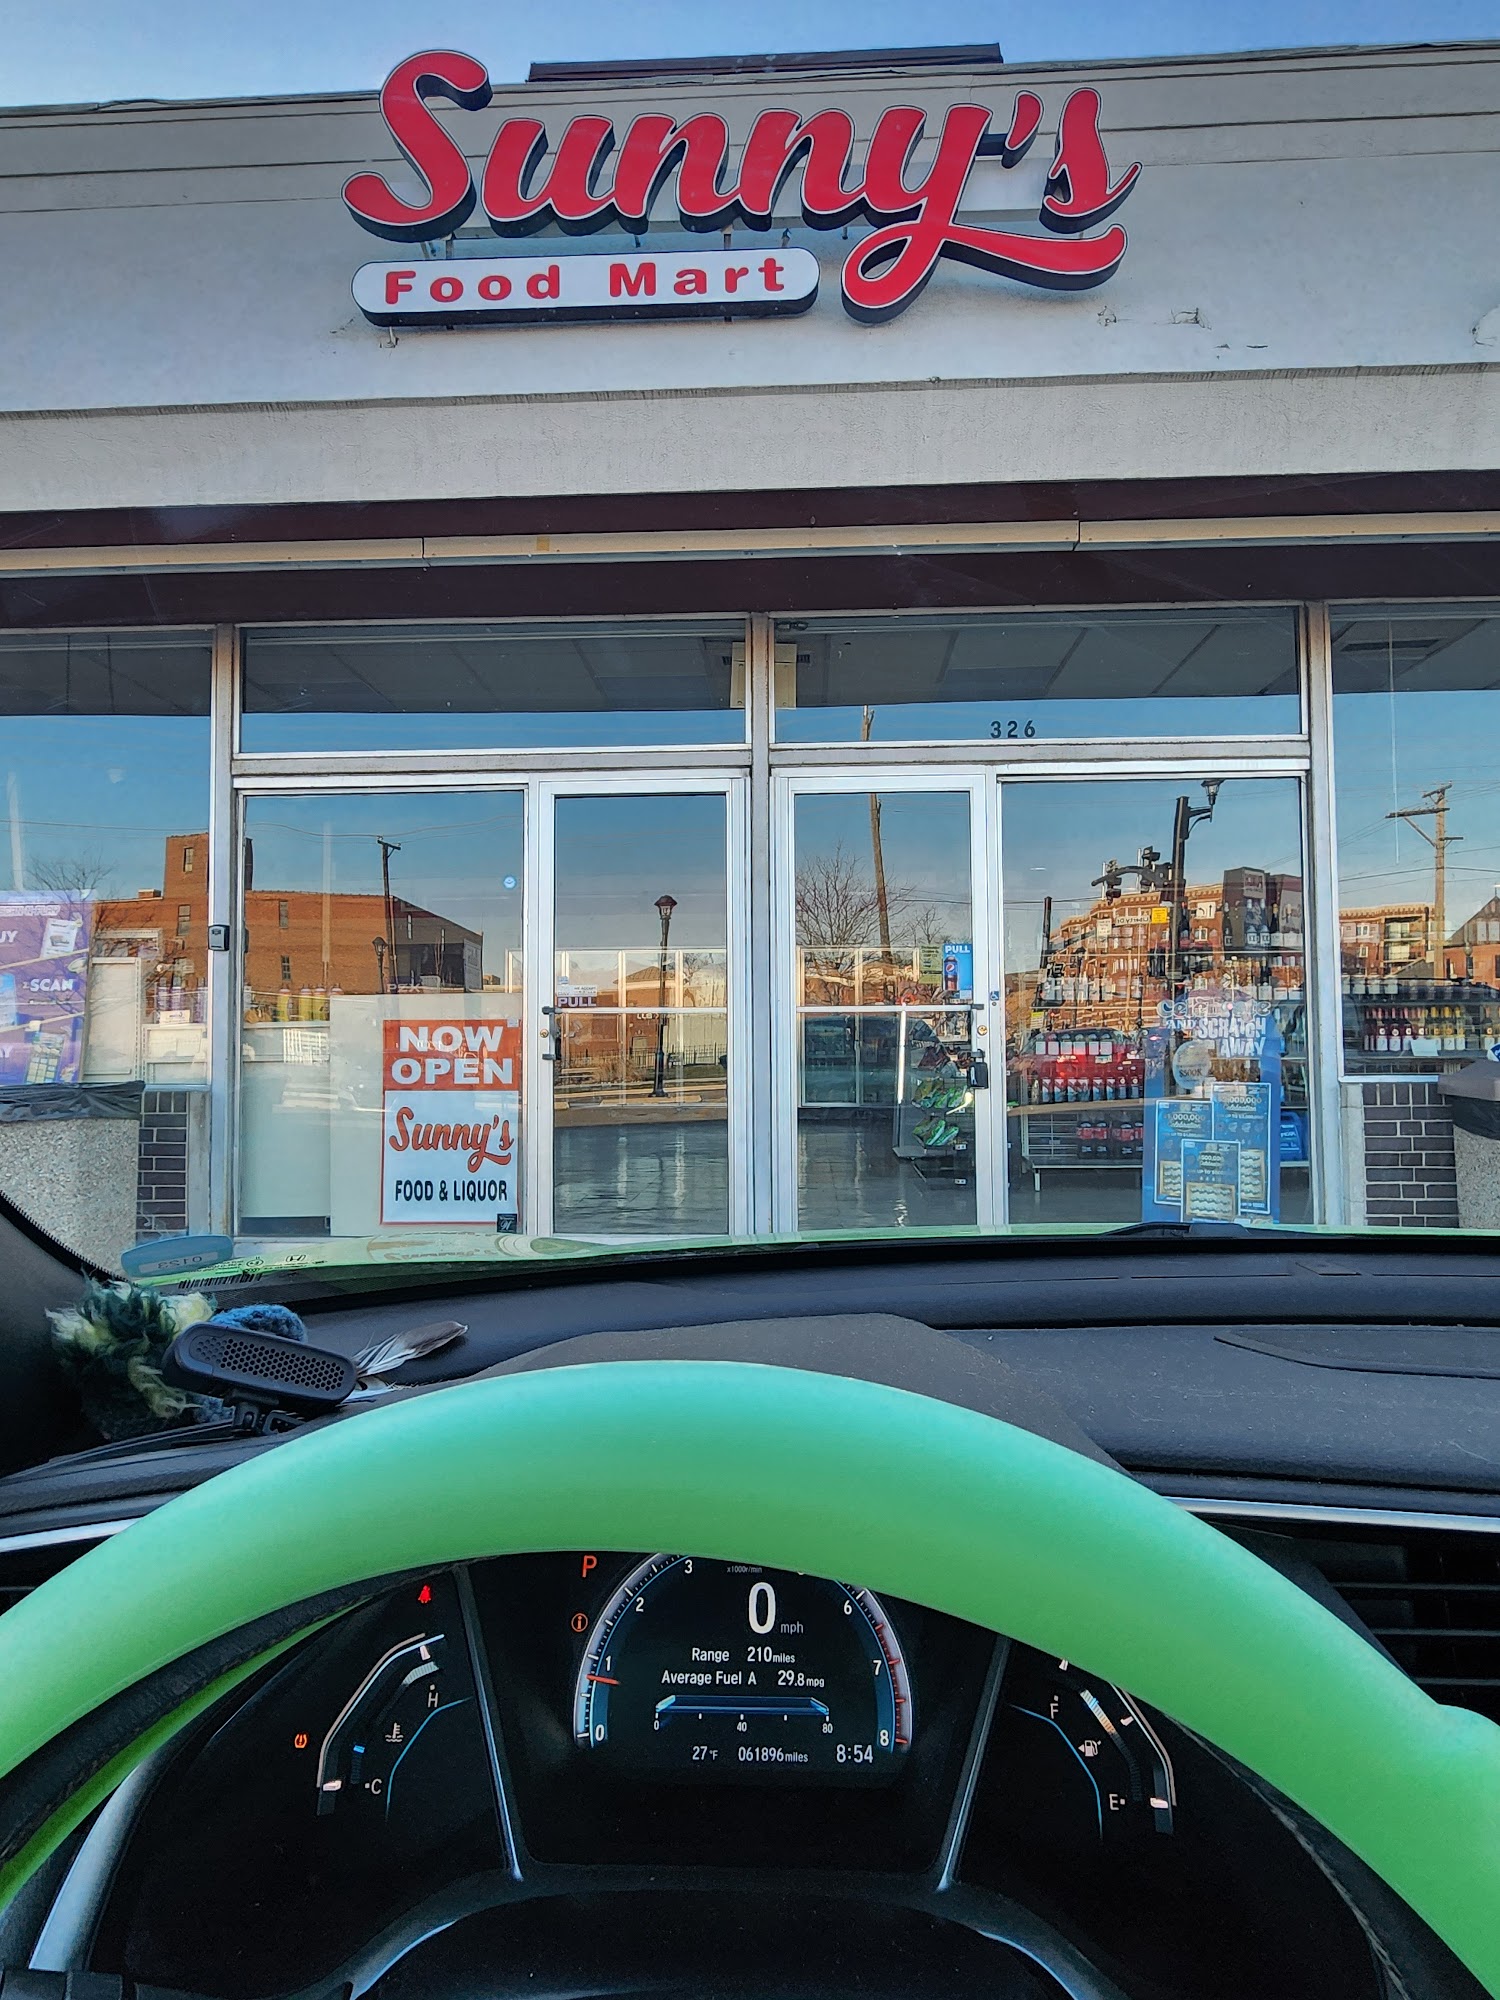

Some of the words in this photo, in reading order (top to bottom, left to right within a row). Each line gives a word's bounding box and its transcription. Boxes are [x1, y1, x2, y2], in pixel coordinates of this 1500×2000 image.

[341, 49, 1142, 322] Sunny's
[384, 263, 560, 305] Food
[609, 257, 787, 299] Mart
[990, 719, 1036, 739] 326
[944, 945, 971, 954] PULL
[30, 978, 74, 992] SCAN
[557, 996, 597, 1008] PULL
[1167, 1019, 1197, 1030] AND
[1198, 1016, 1267, 1039] SCRATCH
[399, 1026, 503, 1052] NOW
[1219, 1036, 1267, 1058] AWAY
[391, 1058, 513, 1084] OPEN
[388, 1106, 515, 1173] Sunny's
[395, 1180, 434, 1202] FOOD
[438, 1180, 449, 1201] &
[453, 1179, 508, 1202] LIQUOR
[582, 1555, 597, 1578] P
[684, 1560, 693, 1574] 3
[635, 1597, 644, 1613] 2
[749, 1582, 776, 1634] 0
[780, 1621, 804, 1635] mph
[843, 1599, 853, 1615] 6
[605, 1656, 612, 1672] 1
[691, 1647, 730, 1665] Range
[747, 1646, 773, 1663] 210
[773, 1652, 796, 1664] miles
[873, 1659, 882, 1676] 7
[661, 1669, 712, 1688] Average
[715, 1670, 742, 1685] Fuel
[748, 1671, 757, 1685] A
[777, 1669, 805, 1687] 29.8
[806, 1678, 825, 1689] mpg
[428, 1692, 439, 1708] H
[1050, 1702, 1059, 1719] F
[595, 1723, 606, 1742] 0
[654, 1719, 660, 1731] 0
[736, 1721, 748, 1733] 40
[822, 1722, 834, 1735] 80
[879, 1729, 889, 1746] 8
[738, 1746, 784, 1762] 061896
[784, 1751, 809, 1763] miles
[836, 1744, 874, 1764] 8:54
[371, 1778, 383, 1795] C
[1109, 1793, 1120, 1811] E
